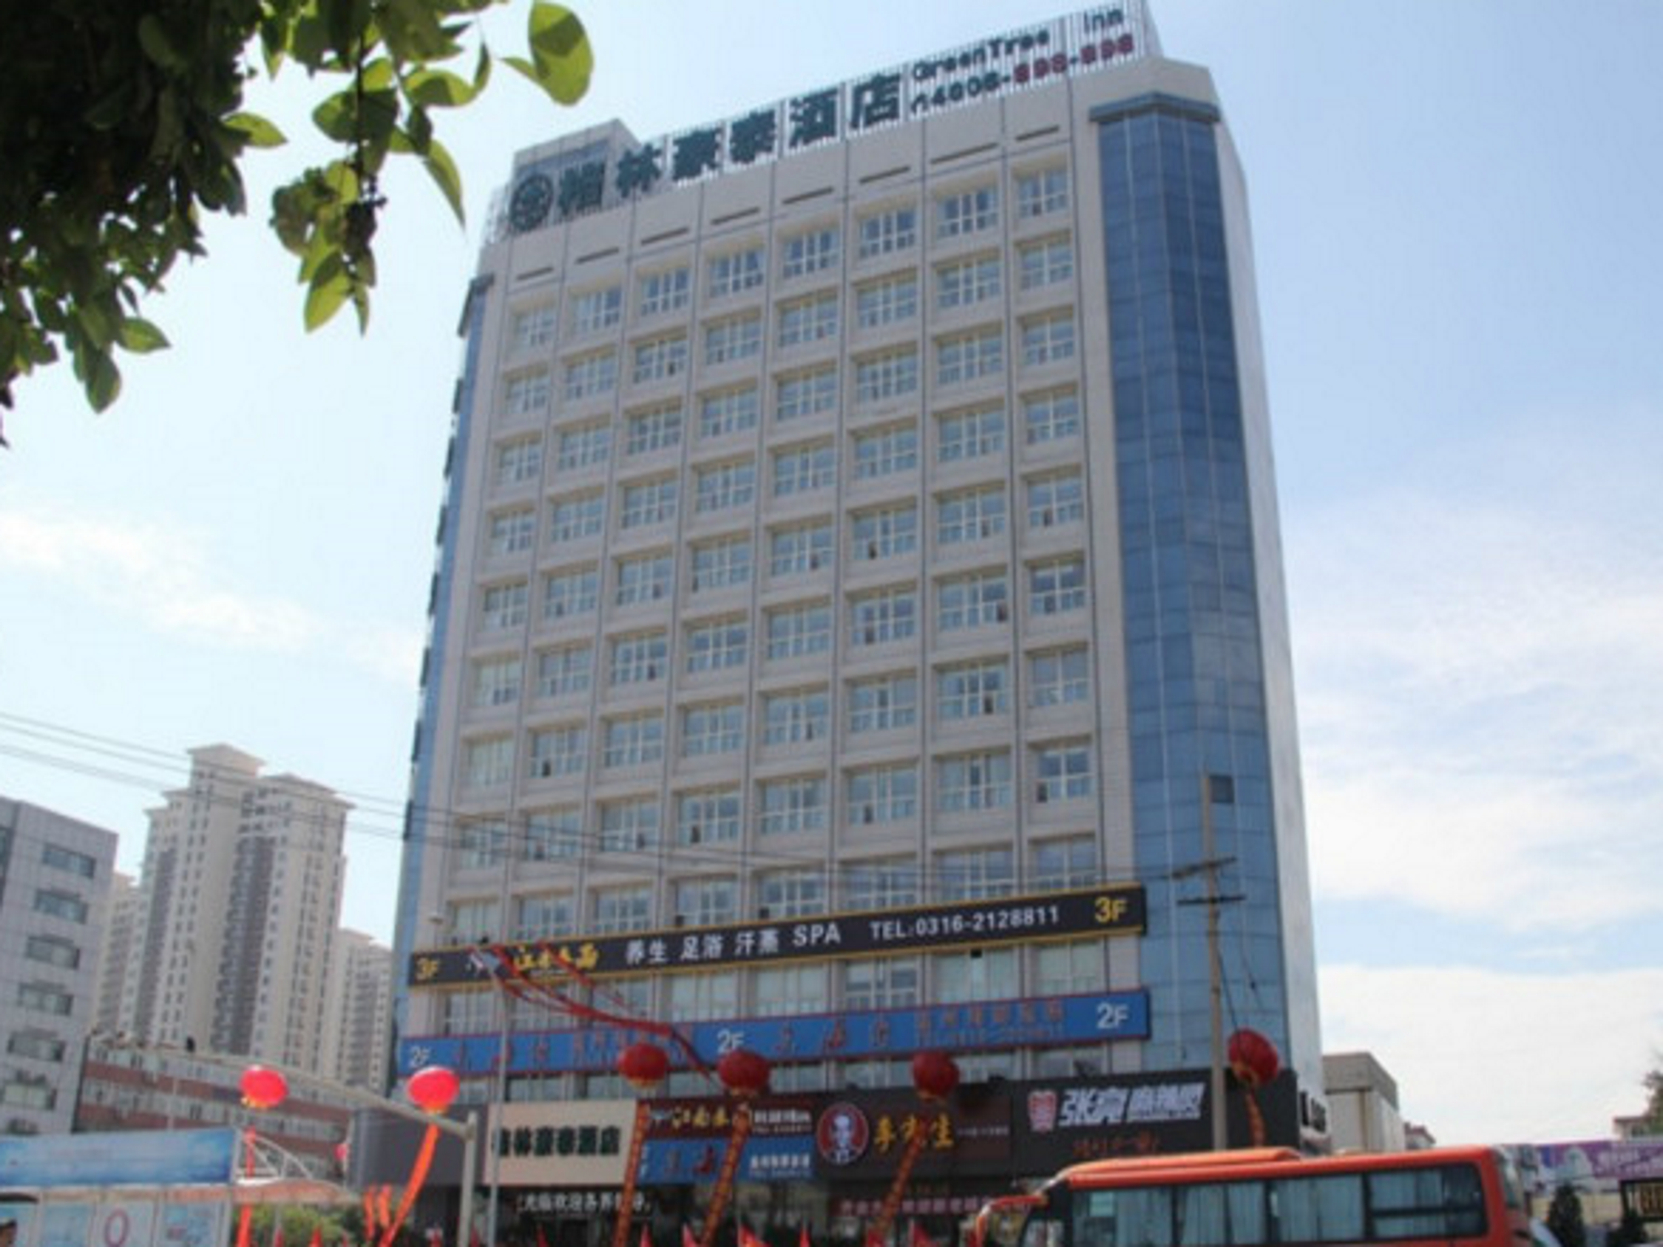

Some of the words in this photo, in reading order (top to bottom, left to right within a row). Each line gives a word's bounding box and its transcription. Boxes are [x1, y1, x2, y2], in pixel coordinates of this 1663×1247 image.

[912, 29, 1049, 81] GreenTree
[1083, 7, 1124, 34] Inn
[1094, 896, 1128, 924] 3F
[625, 940, 669, 965] 养生
[793, 921, 841, 947] SPA
[415, 956, 440, 980] 3F
[1097, 1003, 1129, 1030] 2F
[717, 1029, 745, 1053] 2F
